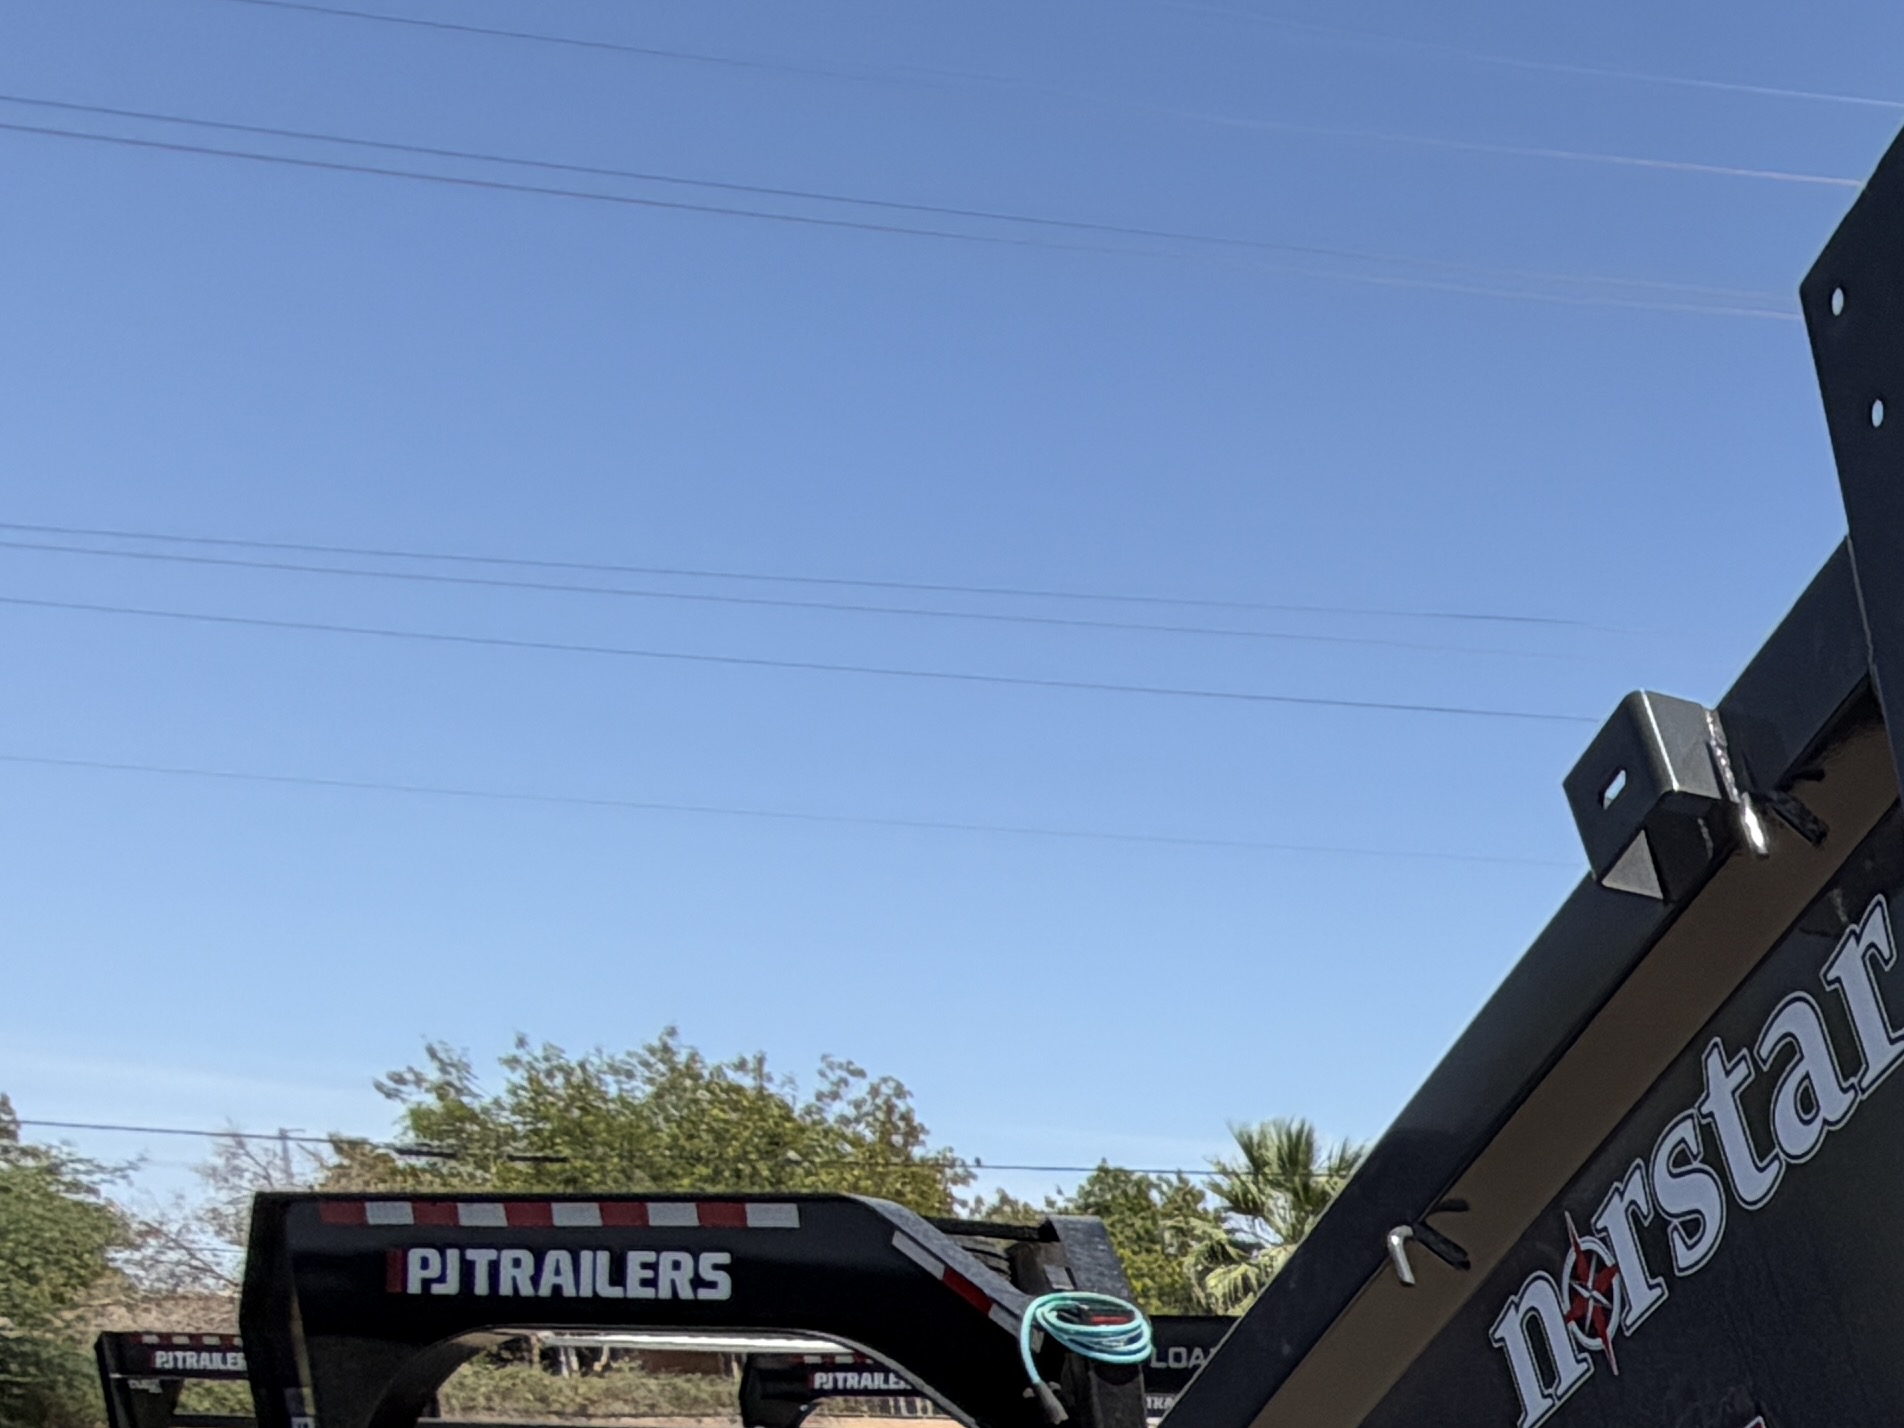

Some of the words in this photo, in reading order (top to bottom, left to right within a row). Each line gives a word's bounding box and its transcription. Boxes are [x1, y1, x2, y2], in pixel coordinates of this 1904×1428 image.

[407, 1247, 460, 1295] PJ
[465, 1248, 732, 1300] TRAILERS
[1150, 1346, 1214, 1369] LOA
[834, 1372, 912, 1390] TRAILE
